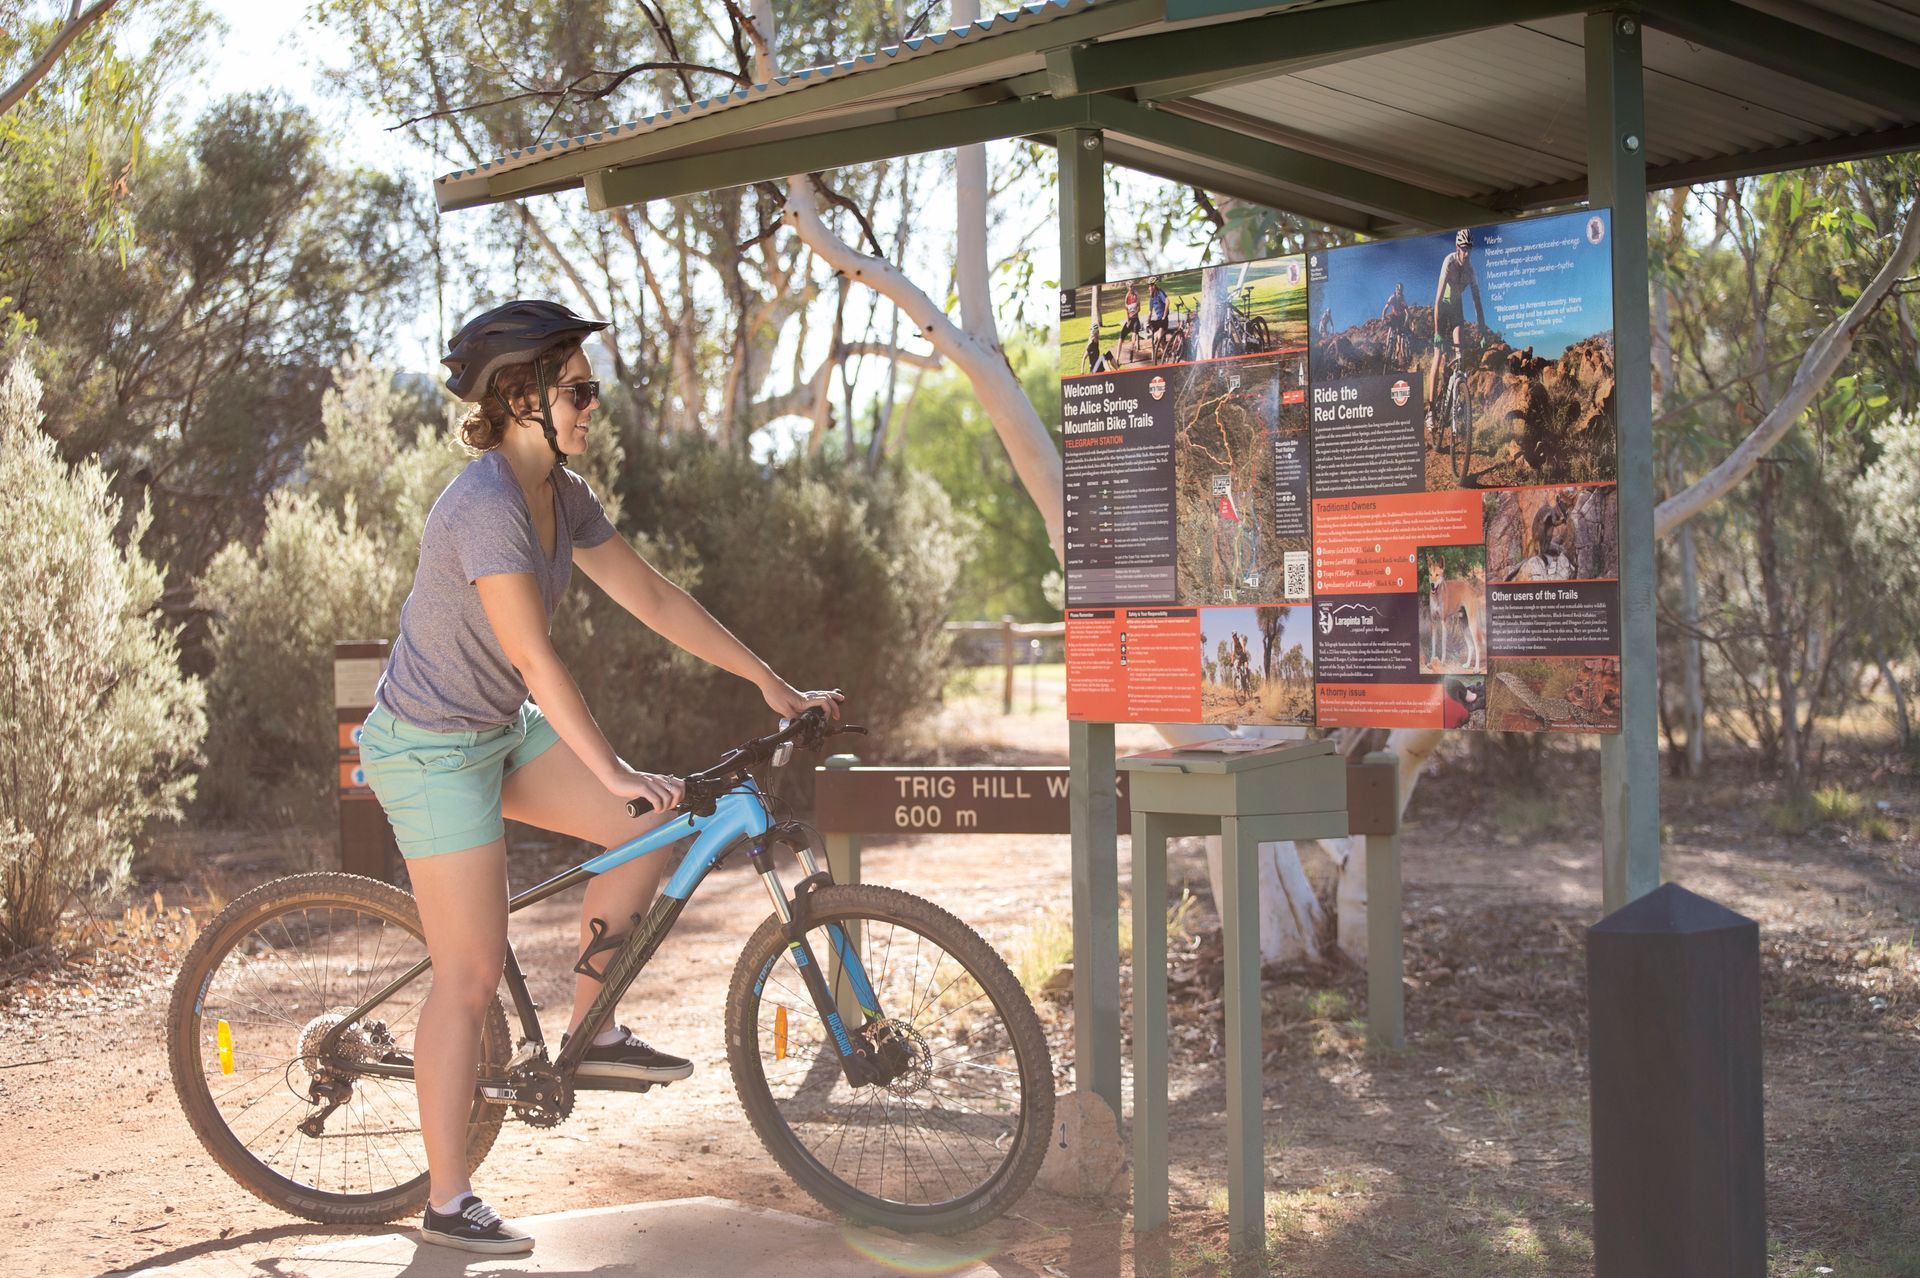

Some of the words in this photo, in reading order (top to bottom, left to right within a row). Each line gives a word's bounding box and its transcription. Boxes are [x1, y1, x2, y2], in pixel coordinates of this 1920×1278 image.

[1502, 313, 1515, 322] good
[1064, 384, 1103, 398] Welcome
[1105, 381, 1114, 394] to
[1314, 388, 1338, 403] Ride
[1340, 386, 1358, 401] the
[1064, 403, 1078, 416] the
[1080, 401, 1101, 415] Alice
[1104, 397, 1138, 414] Springs
[1314, 406, 1335, 422] Red
[1338, 404, 1373, 420] Centre
[1064, 418, 1104, 435] Mountain
[1107, 416, 1126, 431] Bike
[1128, 413, 1154, 428] Trails
[1065, 437, 1098, 448] TELEGRAPH
[1100, 435, 1124, 445] STATION
[1316, 502, 1350, 512] Traditional
[1352, 501, 1376, 510] Owners
[1492, 591, 1512, 601] Other
[1513, 591, 1533, 600] users
[1536, 590, 1542, 600] of
[1544, 590, 1556, 600] the
[1558, 589, 1578, 600] Trails
[1335, 616, 1360, 627] Larapinta
[1362, 616, 1373, 625] Trail
[1326, 688, 1347, 698] thorny
[1348, 687, 1366, 696] issue
[895, 776, 956, 798] TRIG
[973, 776, 1031, 798] HILL
[1046, 776, 1123, 798] WK
[894, 805, 941, 827] 600
[956, 809, 977, 827] m
[827, 1012, 854, 1056] ROCKSHOX
[286, 1195, 408, 1214] SCHWALBE
